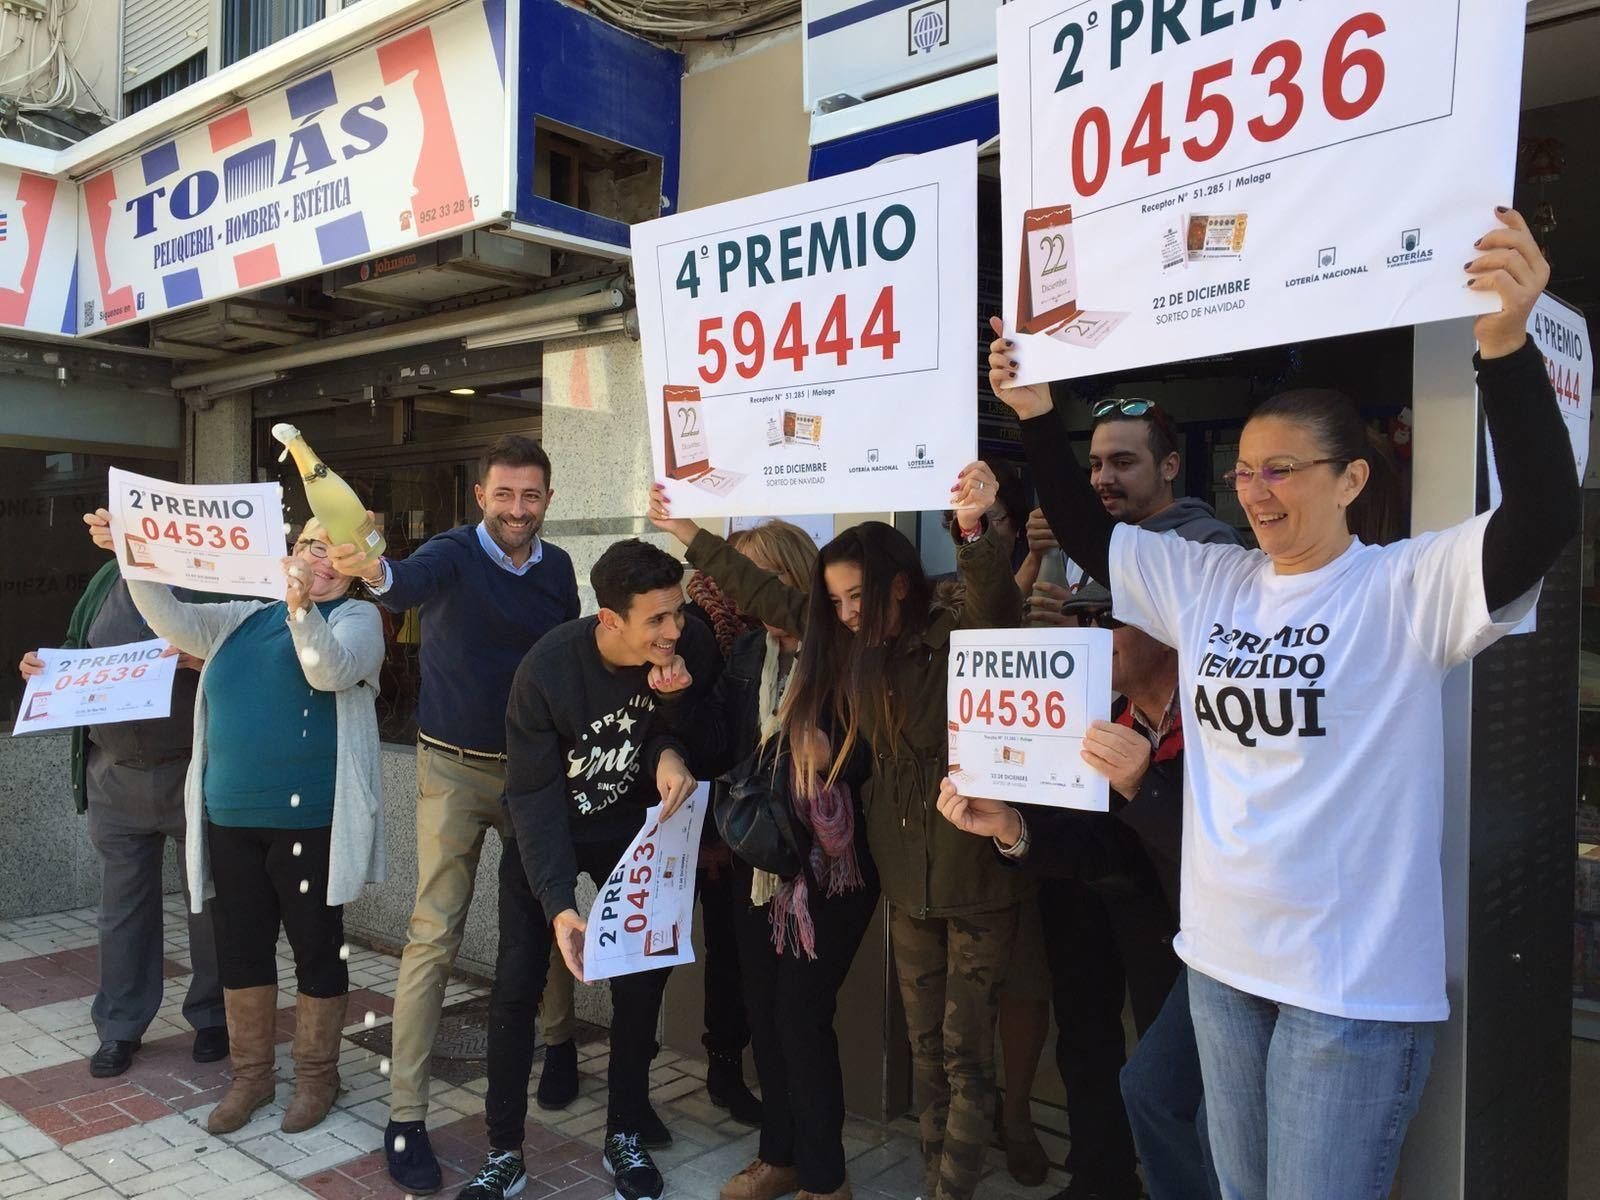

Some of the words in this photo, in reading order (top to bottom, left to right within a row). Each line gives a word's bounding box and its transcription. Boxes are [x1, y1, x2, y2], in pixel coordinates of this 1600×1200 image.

[1053, 11, 1099, 93] 2º
[1071, 12, 1387, 198] 04536
[420, 208, 437, 223] 952
[439, 203, 451, 218] 33
[453, 200, 465, 214] 28
[468, 195, 480, 209] 15
[1141, 199, 1175, 214] Receptor
[1193, 183, 1224, 199] 51.285
[1235, 172, 1271, 188] Malaga
[154, 225, 214, 269] PELUQUERIA
[225, 201, 281, 245] HOMBRES
[293, 176, 351, 223] ESTÉTICA
[675, 245, 710, 299] 4º
[718, 203, 916, 293] PREMIO
[1040, 234, 1068, 277] 22
[1387, 249, 1433, 264] LOTERÍAS
[1285, 273, 1319, 288] LOTERÍA
[1322, 265, 1368, 280] NACIONAL
[1152, 297, 1166, 309] 22
[1169, 292, 1183, 306] DE
[1186, 278, 1250, 302] DICIEMBRE
[1156, 310, 1188, 325] SORTEO
[1191, 307, 1202, 318] DE
[1204, 299, 1245, 315] NAVIDAD
[697, 285, 901, 384] 59444
[1544, 315, 1583, 361] PREMIO
[1542, 355, 1580, 409] 9444
[678, 407, 700, 437] 22
[763, 466, 773, 475] 22
[774, 465, 784, 475] DE
[786, 462, 827, 474] DICIEMBRE
[766, 479, 788, 487] SORTEO
[790, 478, 797, 486] DE
[798, 477, 825, 485] NAVIDAD
[151, 493, 254, 519] PREMIO
[141, 517, 250, 551] 04536
[1229, 623, 1330, 654] PRMIO
[77, 648, 163, 670] PREMIO
[972, 650, 1075, 679] PREMIO
[54, 663, 149, 690] 04536
[959, 688, 1066, 729] 04536
[1195, 680, 1326, 747] AQUÍ
[601, 864, 626, 921] PRE
